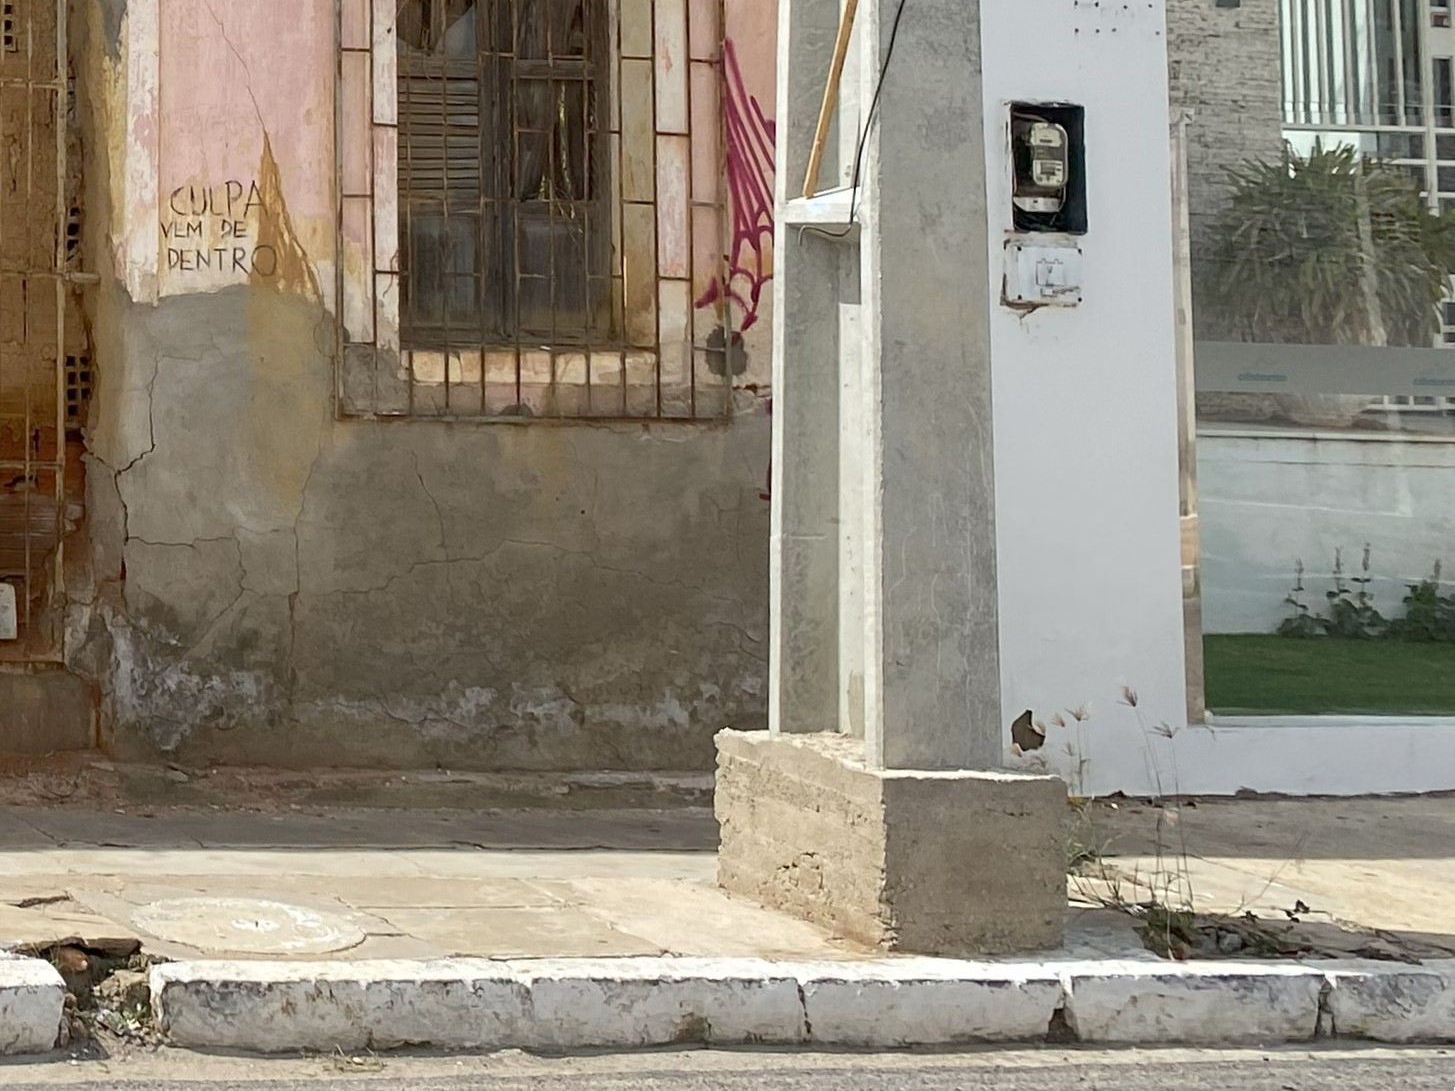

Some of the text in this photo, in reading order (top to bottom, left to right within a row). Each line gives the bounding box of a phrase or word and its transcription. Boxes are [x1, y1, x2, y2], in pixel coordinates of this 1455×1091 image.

[170, 180, 270, 219] CULPA
[221, 219, 248, 238] DE
[168, 244, 277, 277] DENTRO
